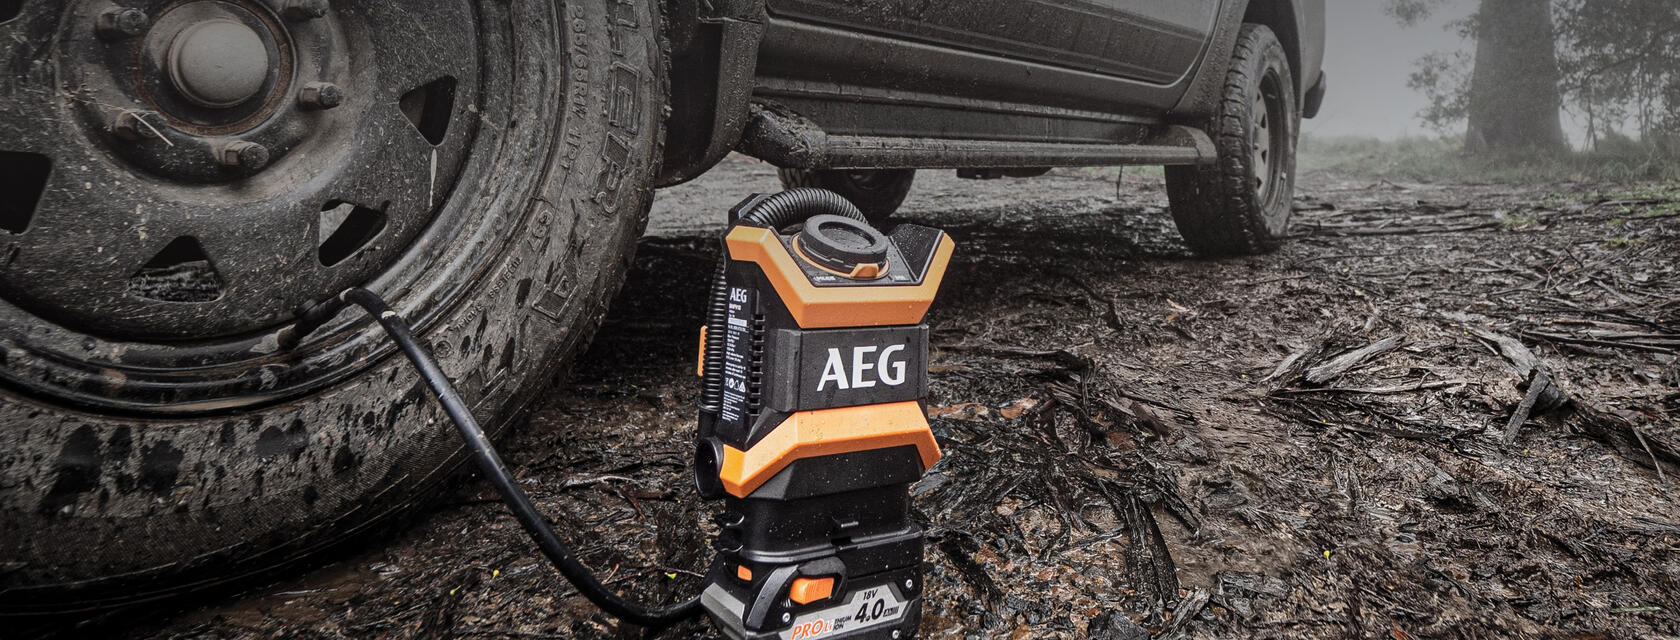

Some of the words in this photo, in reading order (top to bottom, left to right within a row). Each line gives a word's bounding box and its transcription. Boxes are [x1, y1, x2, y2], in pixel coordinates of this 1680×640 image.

[729, 287, 748, 303] AEG
[816, 344, 906, 392] AEG
[863, 589, 878, 600] 18V
[855, 599, 885, 624] 4.0
